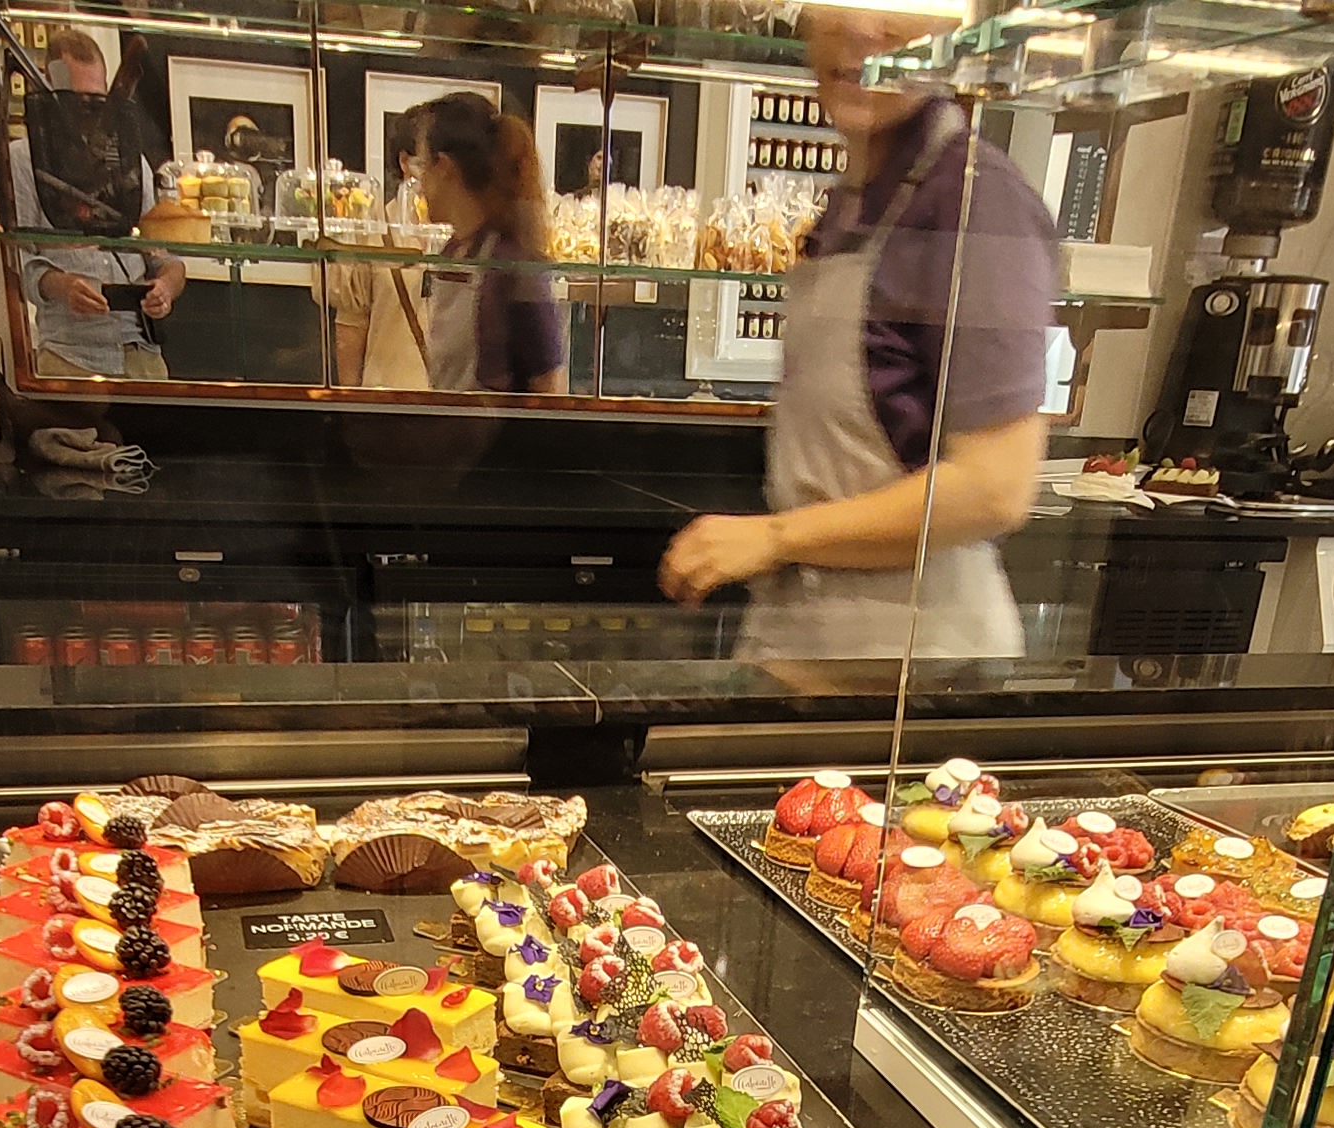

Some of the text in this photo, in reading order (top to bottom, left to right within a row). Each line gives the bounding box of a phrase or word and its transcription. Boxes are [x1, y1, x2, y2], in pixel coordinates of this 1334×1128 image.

[278, 912, 346, 924] TARTE
[250, 918, 377, 934] NORMANDE
[334, 930, 350, 940] €
